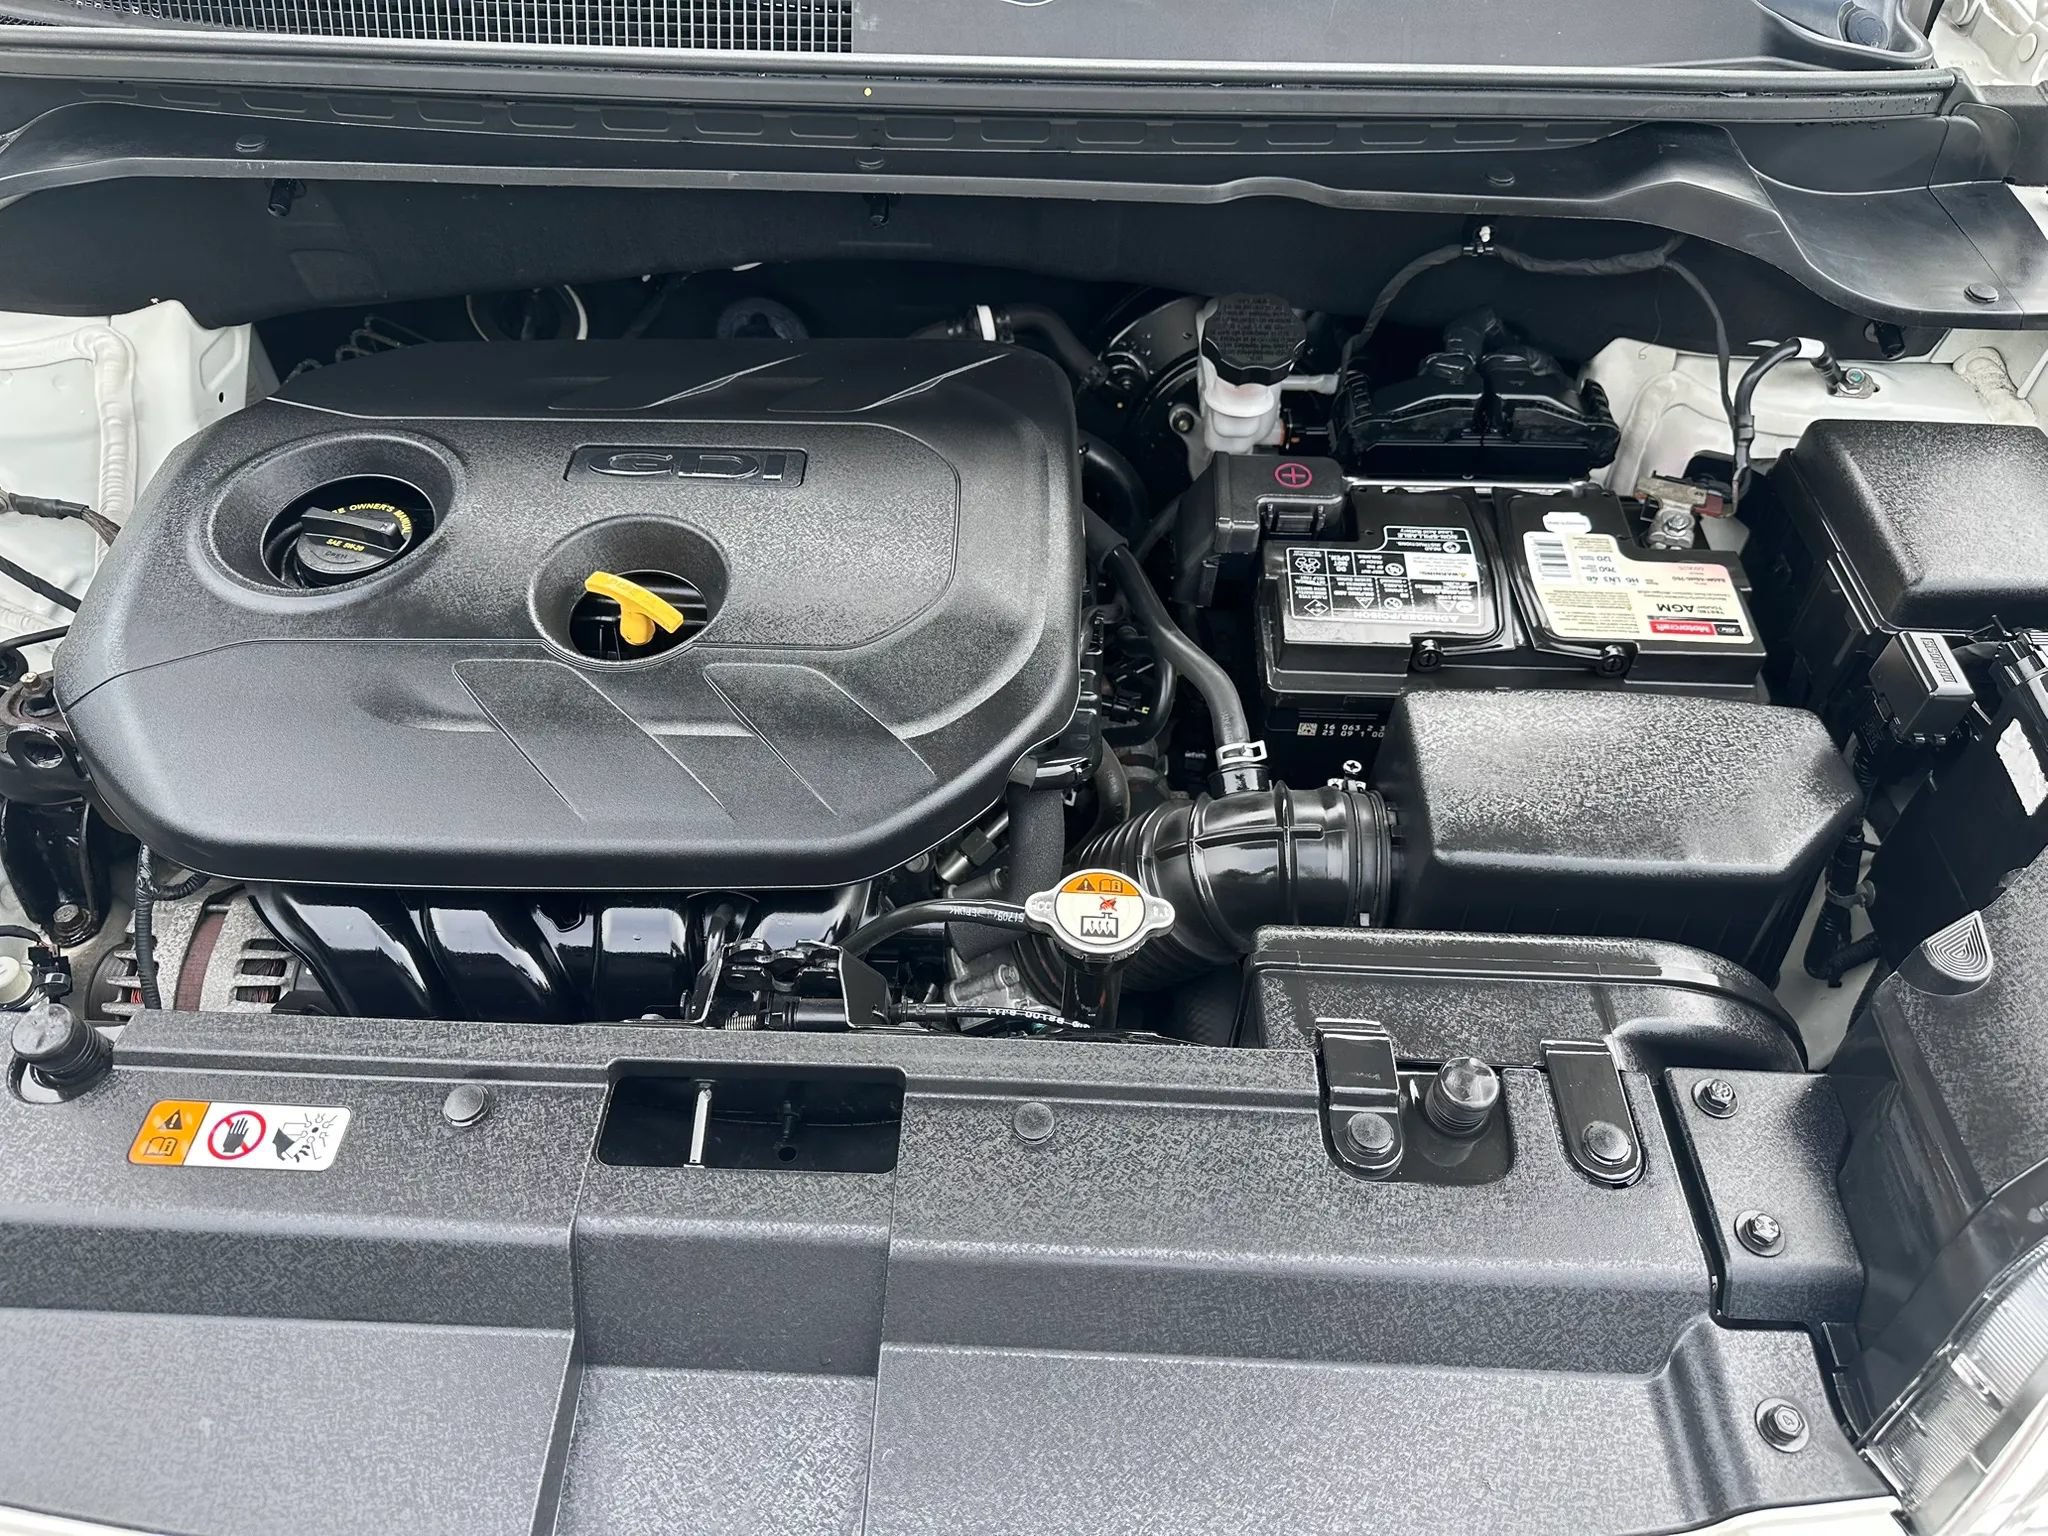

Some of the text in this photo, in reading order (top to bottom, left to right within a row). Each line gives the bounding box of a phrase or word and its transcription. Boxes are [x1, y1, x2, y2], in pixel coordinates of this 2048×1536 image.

[588, 452, 788, 481] GDI
[349, 503, 395, 513] OWNER'S
[1656, 604, 1694, 613] AGM
[1353, 611, 1450, 622] DANGER/POISON
[1656, 624, 1710, 634] Motorcraft
